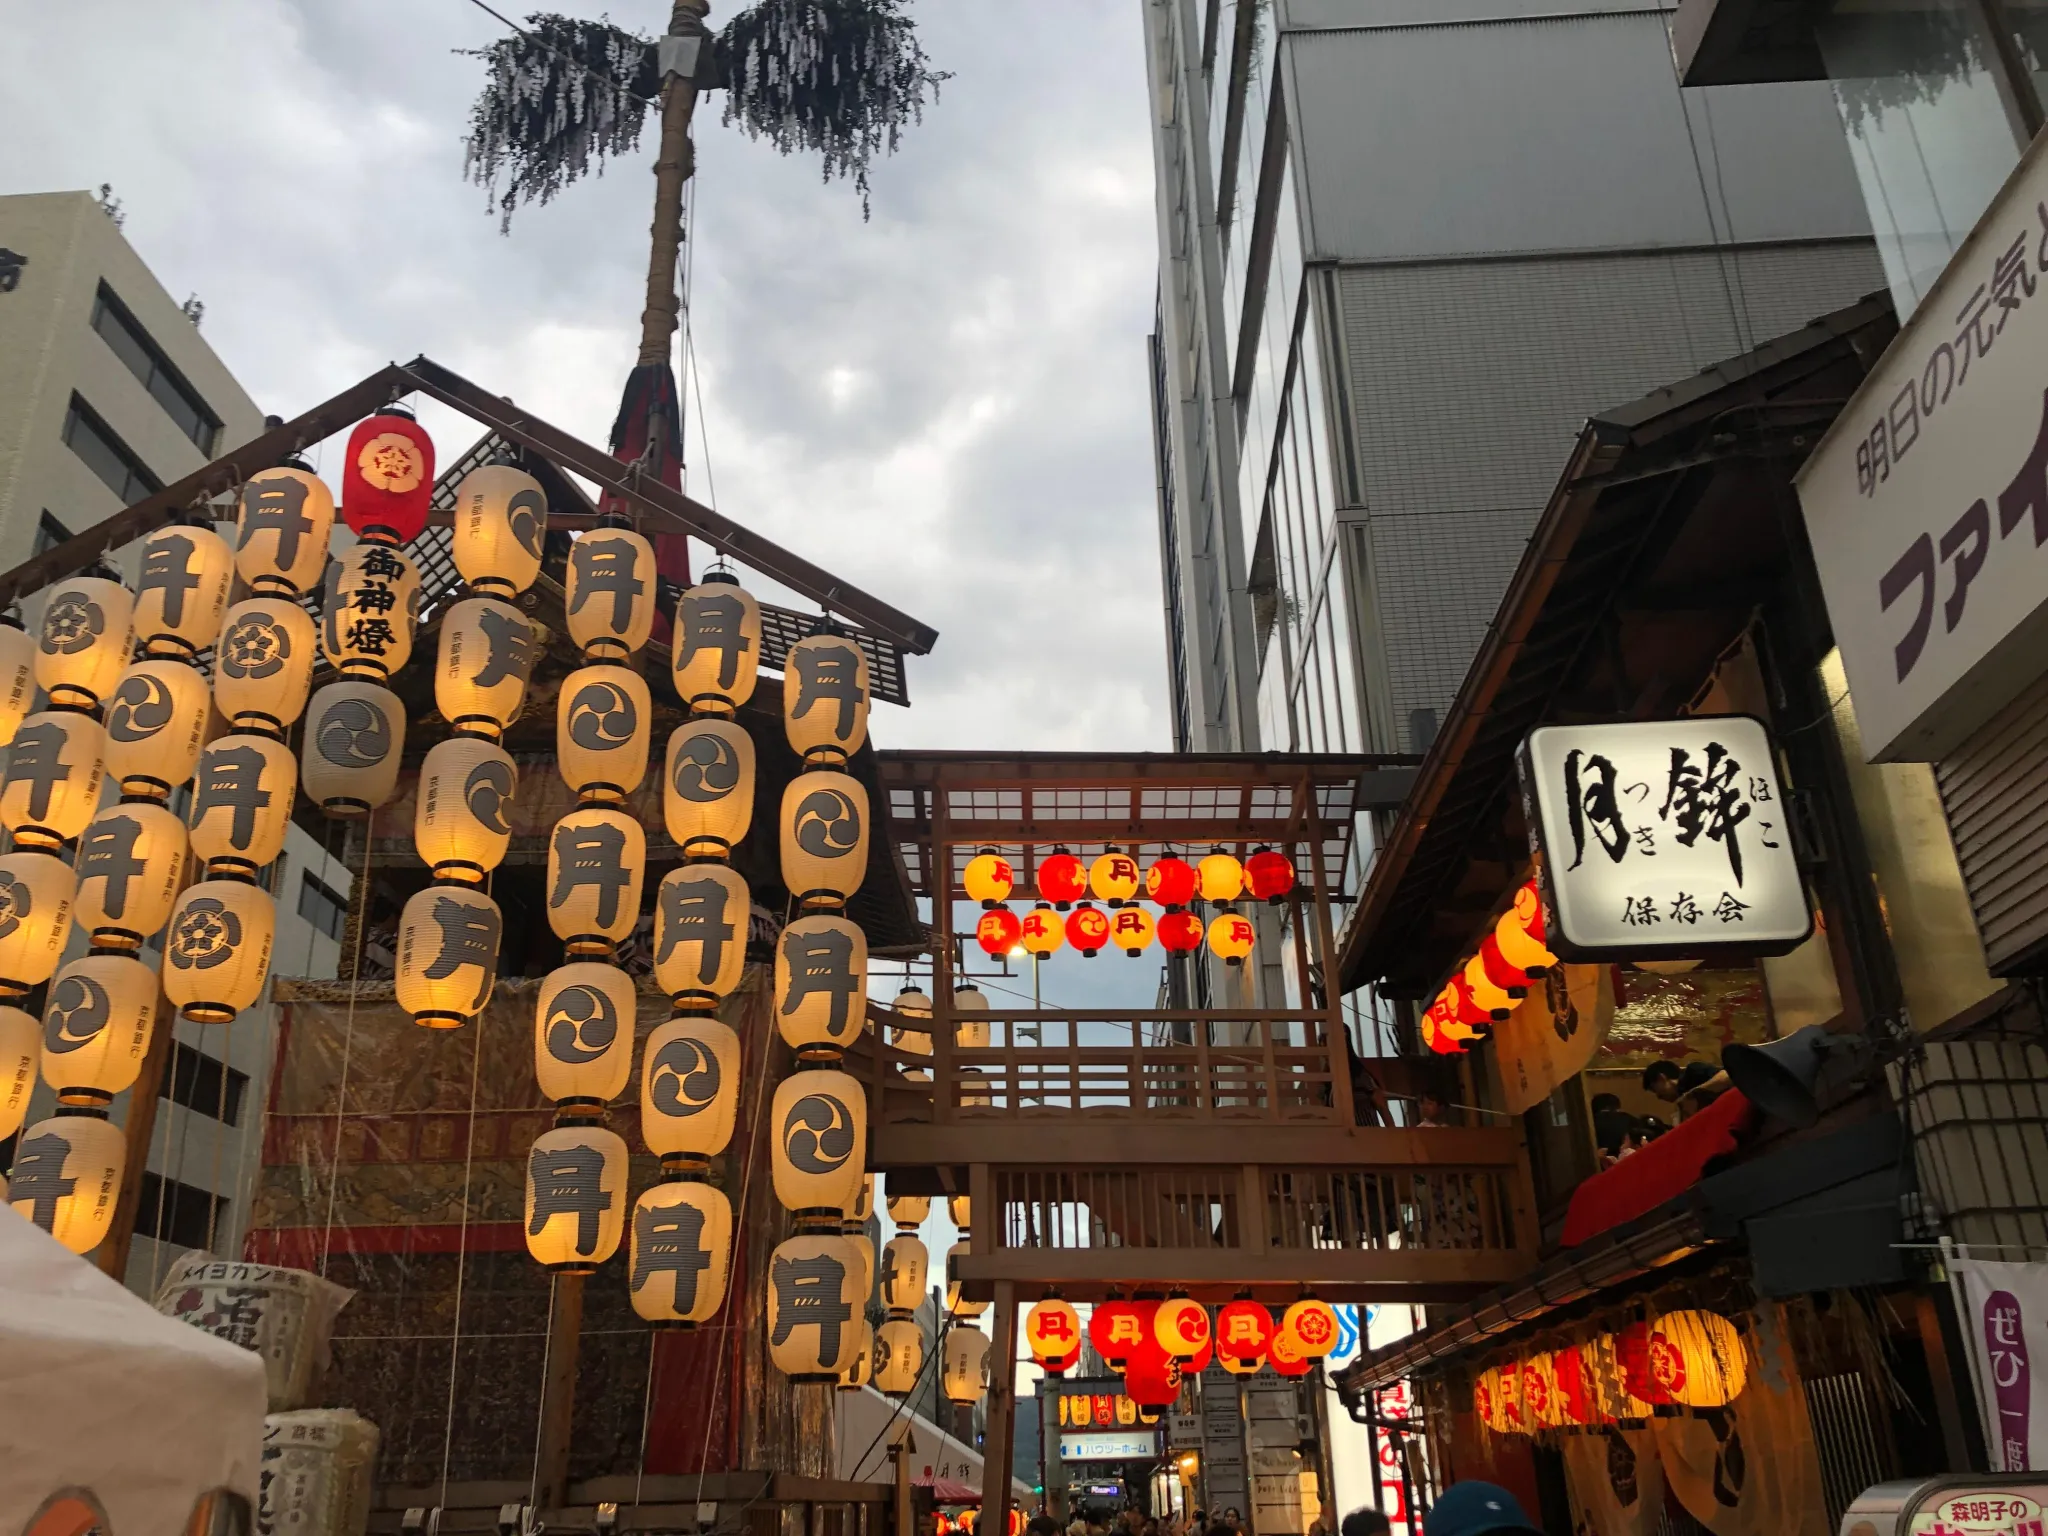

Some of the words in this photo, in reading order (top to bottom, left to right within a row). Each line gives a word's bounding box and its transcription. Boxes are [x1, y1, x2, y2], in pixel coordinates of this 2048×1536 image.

[345, 548, 406, 656] 御神燈
[1622, 892, 1752, 926] 保存会
[181, 1263, 272, 1283] メイヨカン
[1951, 1500, 2028, 1522] 森明子の
